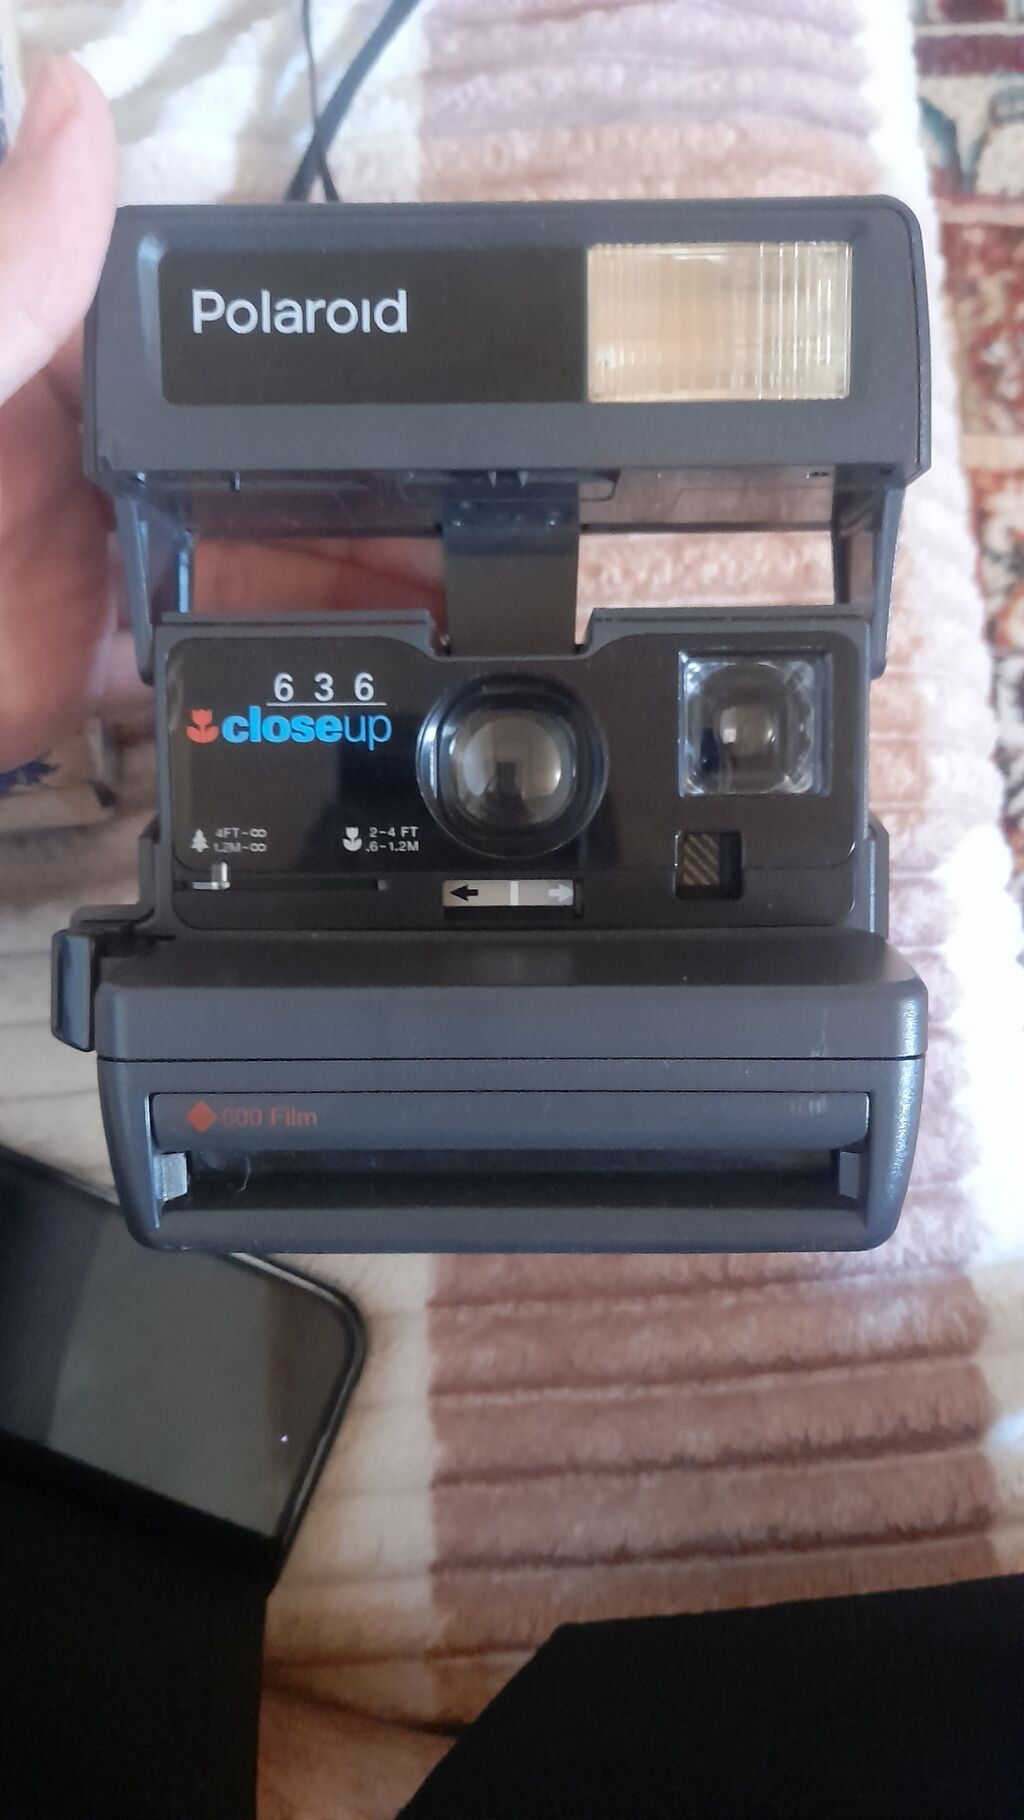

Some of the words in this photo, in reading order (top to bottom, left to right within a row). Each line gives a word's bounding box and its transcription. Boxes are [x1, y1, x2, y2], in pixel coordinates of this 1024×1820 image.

[191, 288, 409, 335] Polaroid
[221, 705, 392, 751] closeup
[268, 1105, 318, 1127] Film
